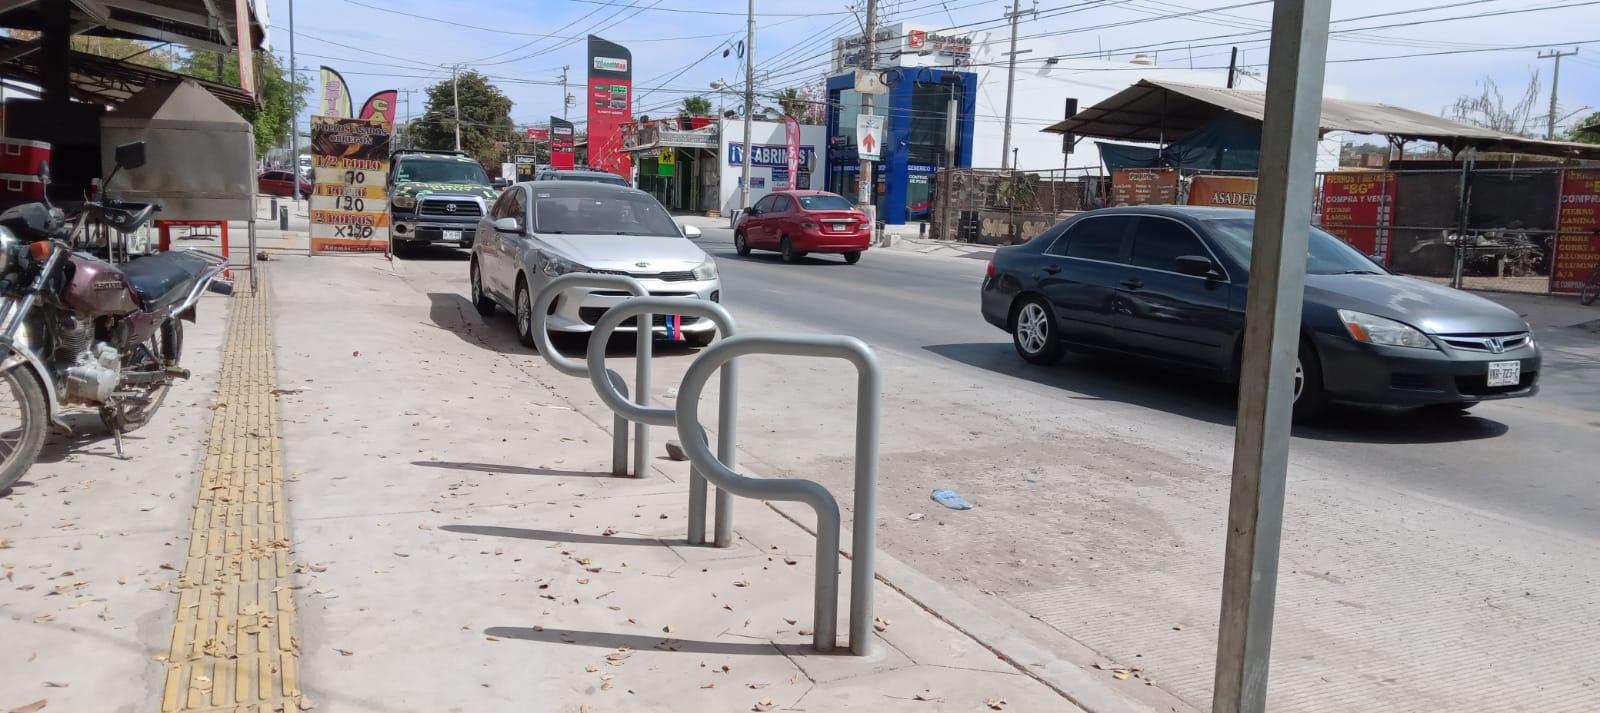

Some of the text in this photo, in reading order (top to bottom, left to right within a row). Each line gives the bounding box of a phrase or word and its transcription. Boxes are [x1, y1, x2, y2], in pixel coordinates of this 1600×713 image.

[316, 154, 382, 170] 1/2 POLLO
[1211, 192, 1257, 206] ASADER
[1325, 194, 1393, 204] COMPRA Y VENTA
[1561, 195, 1600, 204] COMPR
